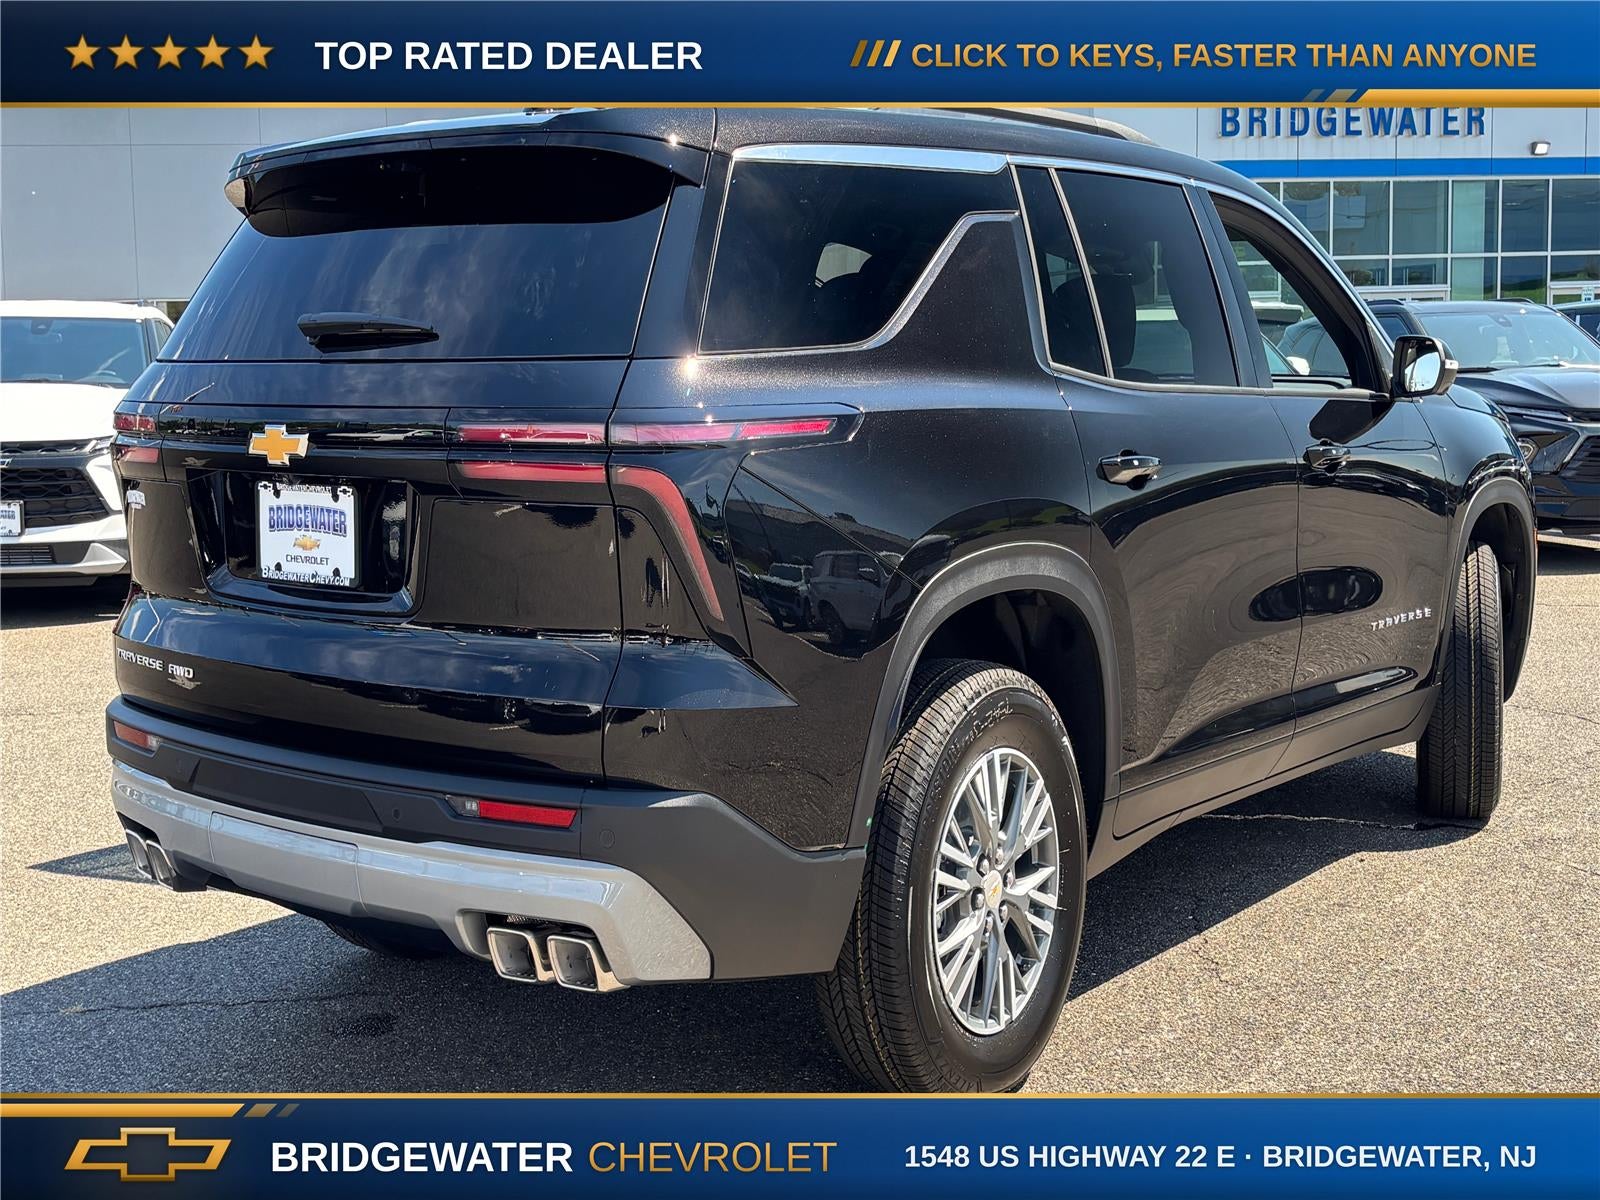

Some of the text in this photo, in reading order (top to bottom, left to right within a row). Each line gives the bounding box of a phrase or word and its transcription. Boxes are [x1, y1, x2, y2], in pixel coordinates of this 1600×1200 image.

[1220, 107, 1486, 137] BRIDGEWATER
[268, 504, 347, 537] BRIDGEWATER
[286, 554, 330, 566] CHEVROLET
[1370, 607, 1432, 632] TRAVERSE
[117, 647, 194, 679] TRAVERSE AWD
